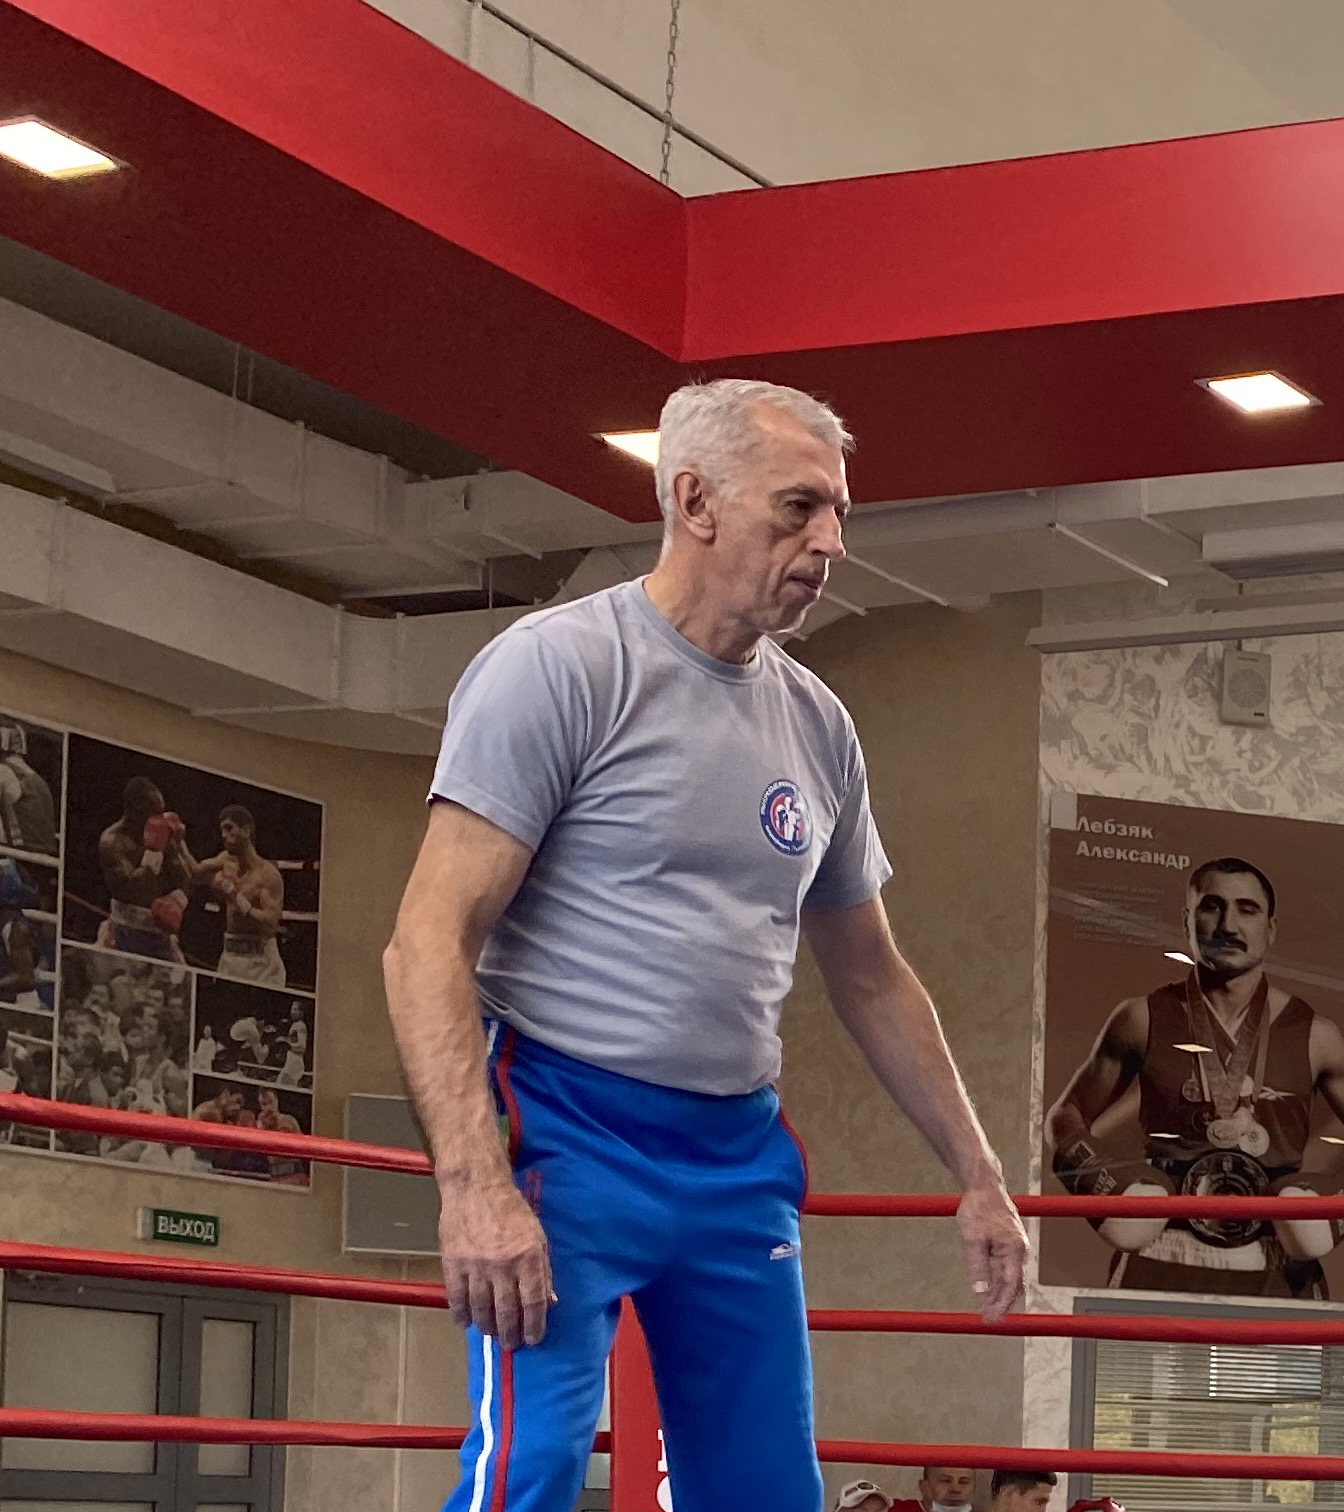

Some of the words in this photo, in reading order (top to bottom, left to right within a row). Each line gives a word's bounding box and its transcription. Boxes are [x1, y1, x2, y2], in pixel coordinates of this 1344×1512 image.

[1077, 816, 1153, 839] Лебзяк
[1077, 840, 1191, 870] Александр
[157, 1215, 215, 1243] ВЫХОД
